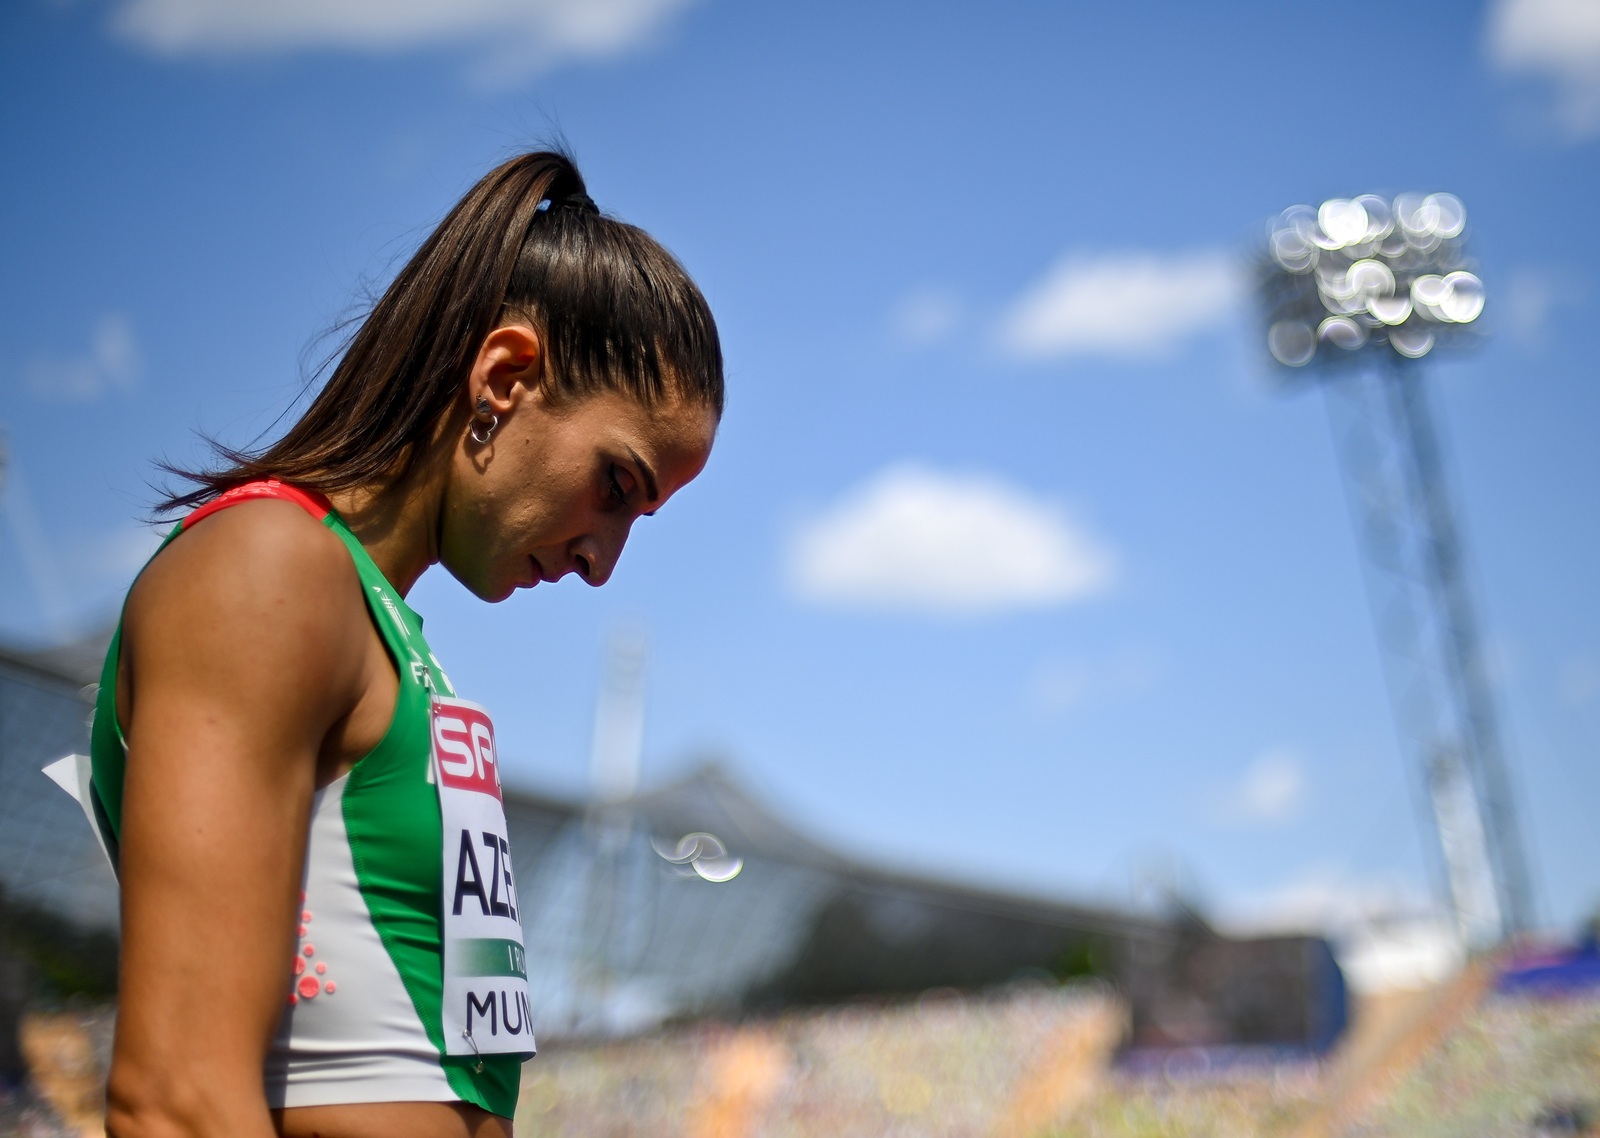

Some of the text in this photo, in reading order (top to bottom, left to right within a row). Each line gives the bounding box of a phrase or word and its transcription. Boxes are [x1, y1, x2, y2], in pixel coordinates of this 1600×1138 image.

[434, 716, 501, 788] SP
[452, 828, 521, 927] AZE
[508, 945, 514, 971] I
